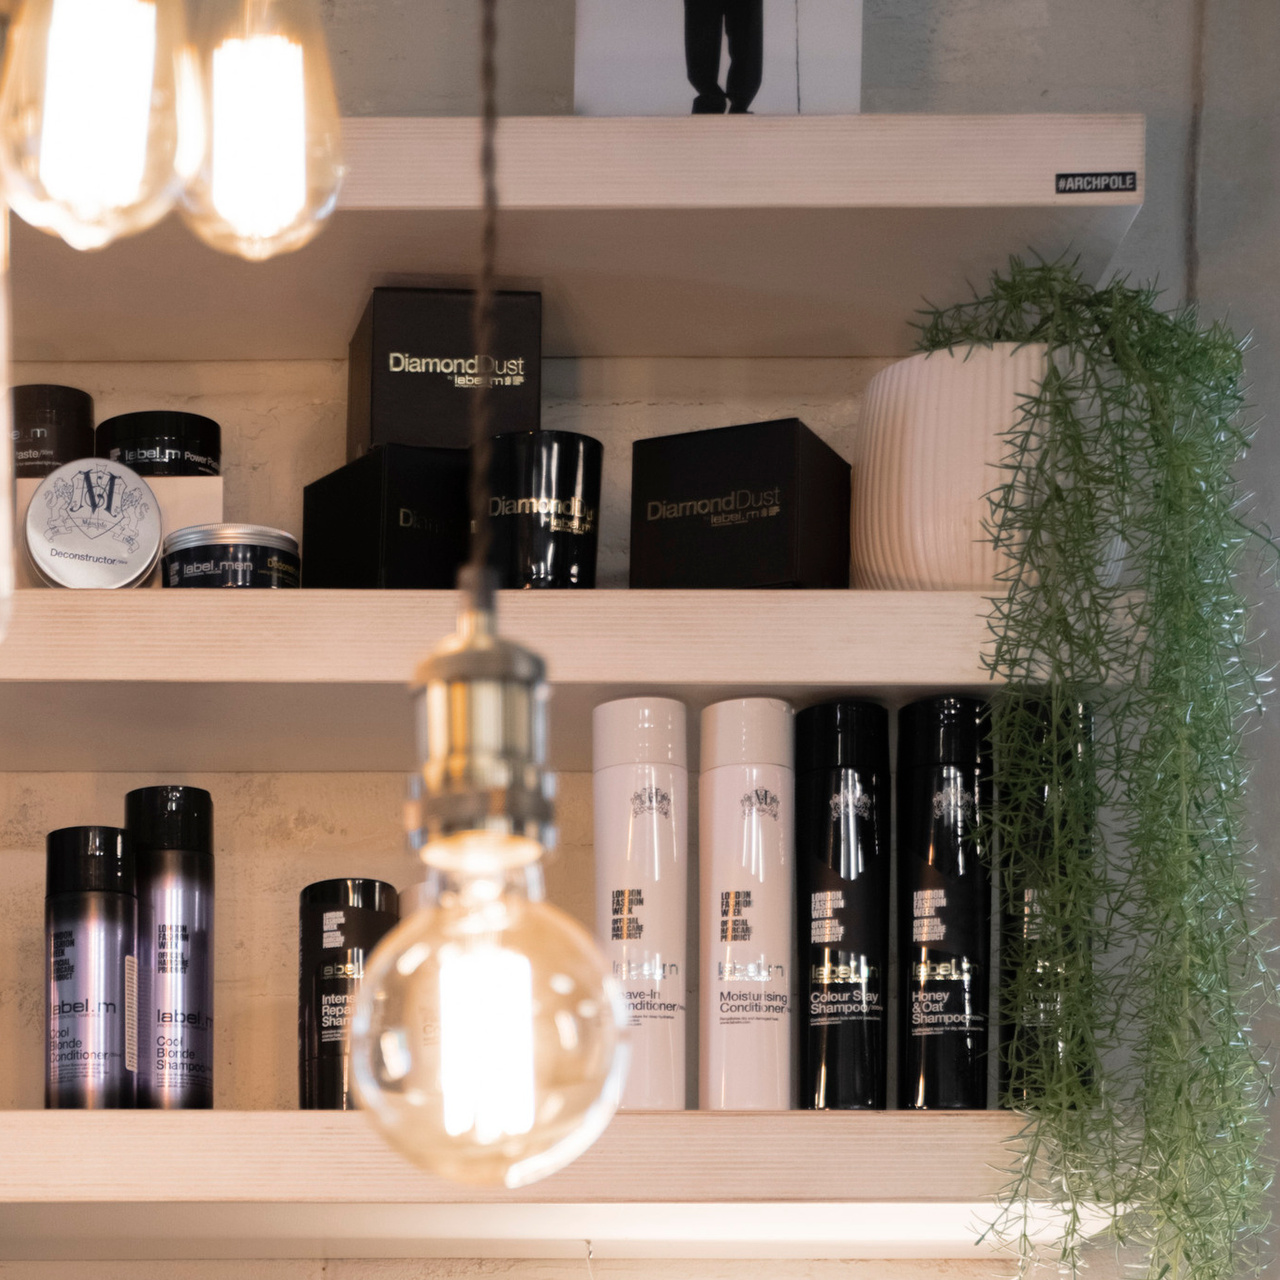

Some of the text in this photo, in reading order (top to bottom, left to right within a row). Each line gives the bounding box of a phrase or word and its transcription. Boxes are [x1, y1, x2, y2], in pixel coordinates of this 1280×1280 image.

[1058, 175, 1134, 191] #ARCHPOLE
[125, 449, 211, 463] label.m Power
[647, 486, 781, 521] DiamondDust
[183, 560, 253, 574] label.men
[720, 991, 788, 1005] Moisturising
[811, 990, 879, 1004] Colour Stay
[912, 992, 950, 1006] Honey
[157, 1035, 183, 1047] Cool
[157, 1048, 196, 1060] Blonde
